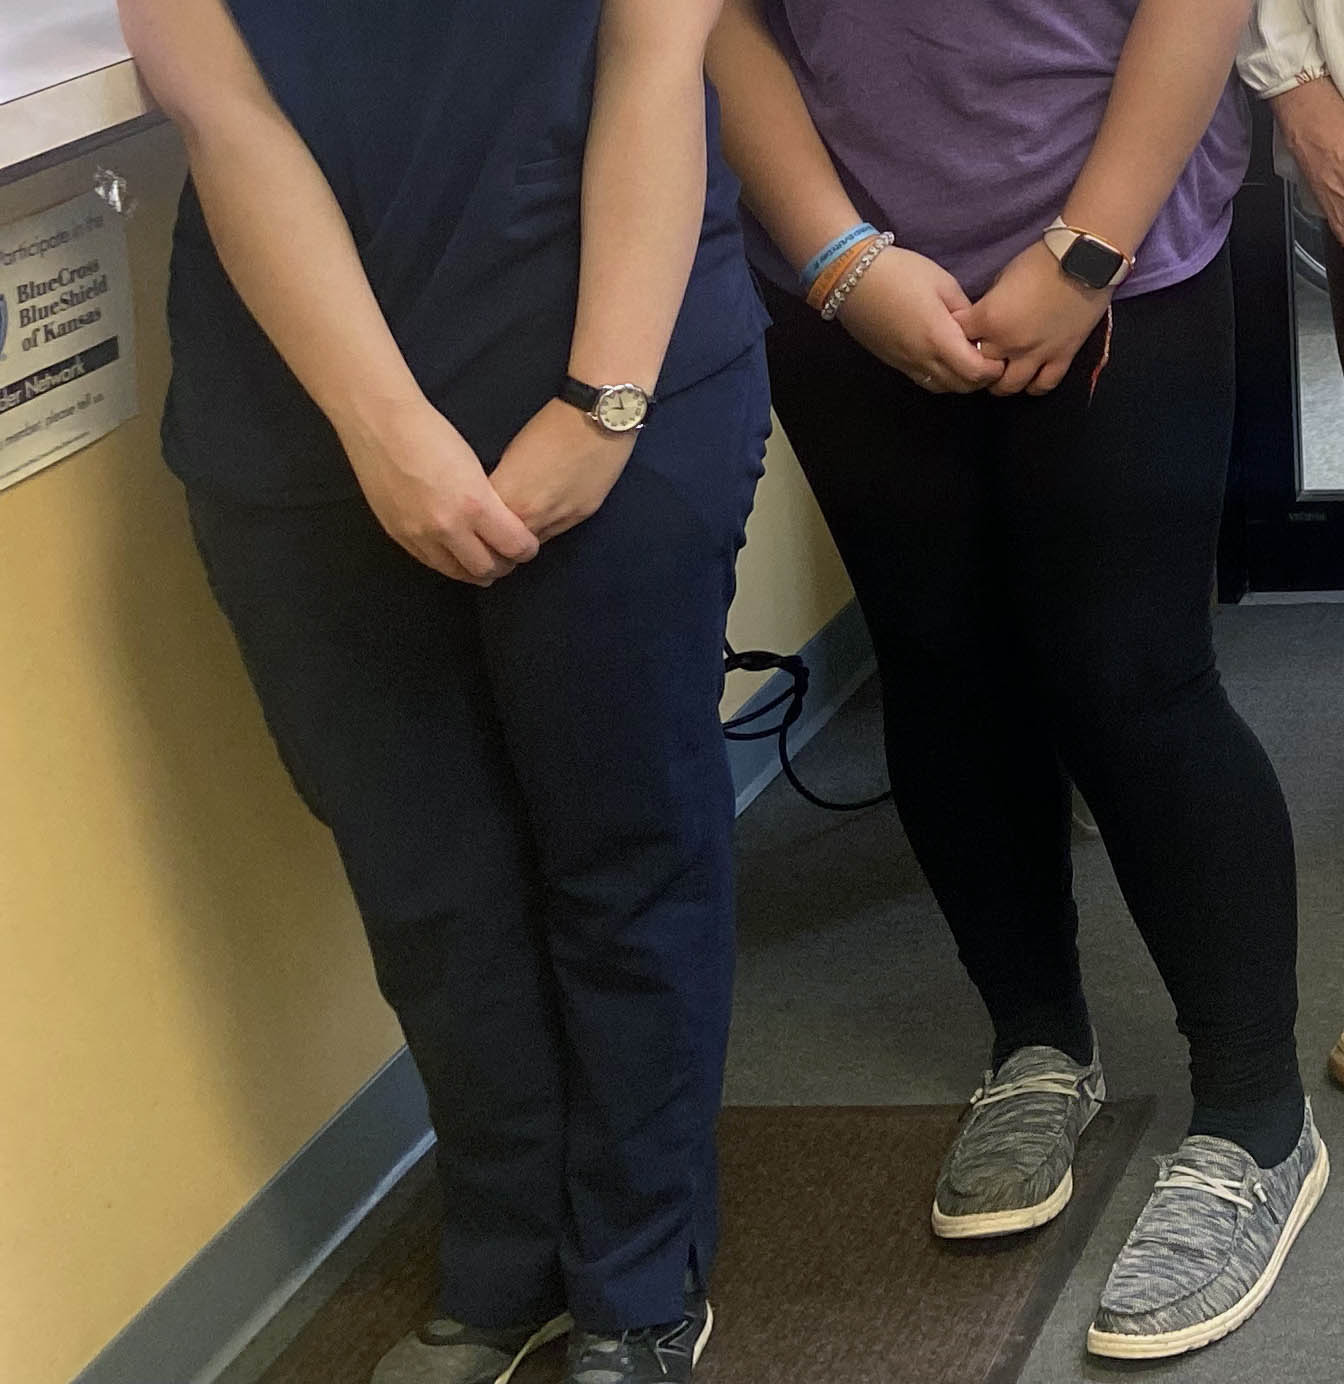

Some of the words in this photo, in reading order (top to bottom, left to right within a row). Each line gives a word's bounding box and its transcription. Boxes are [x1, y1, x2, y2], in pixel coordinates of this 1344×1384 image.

[0, 229, 70, 266] articipate
[17, 260, 100, 304] BlueCross
[18, 276, 108, 328] BlueShield
[22, 328, 39, 352] of
[43, 308, 102, 341] Kansas
[25, 355, 86, 399] Network
